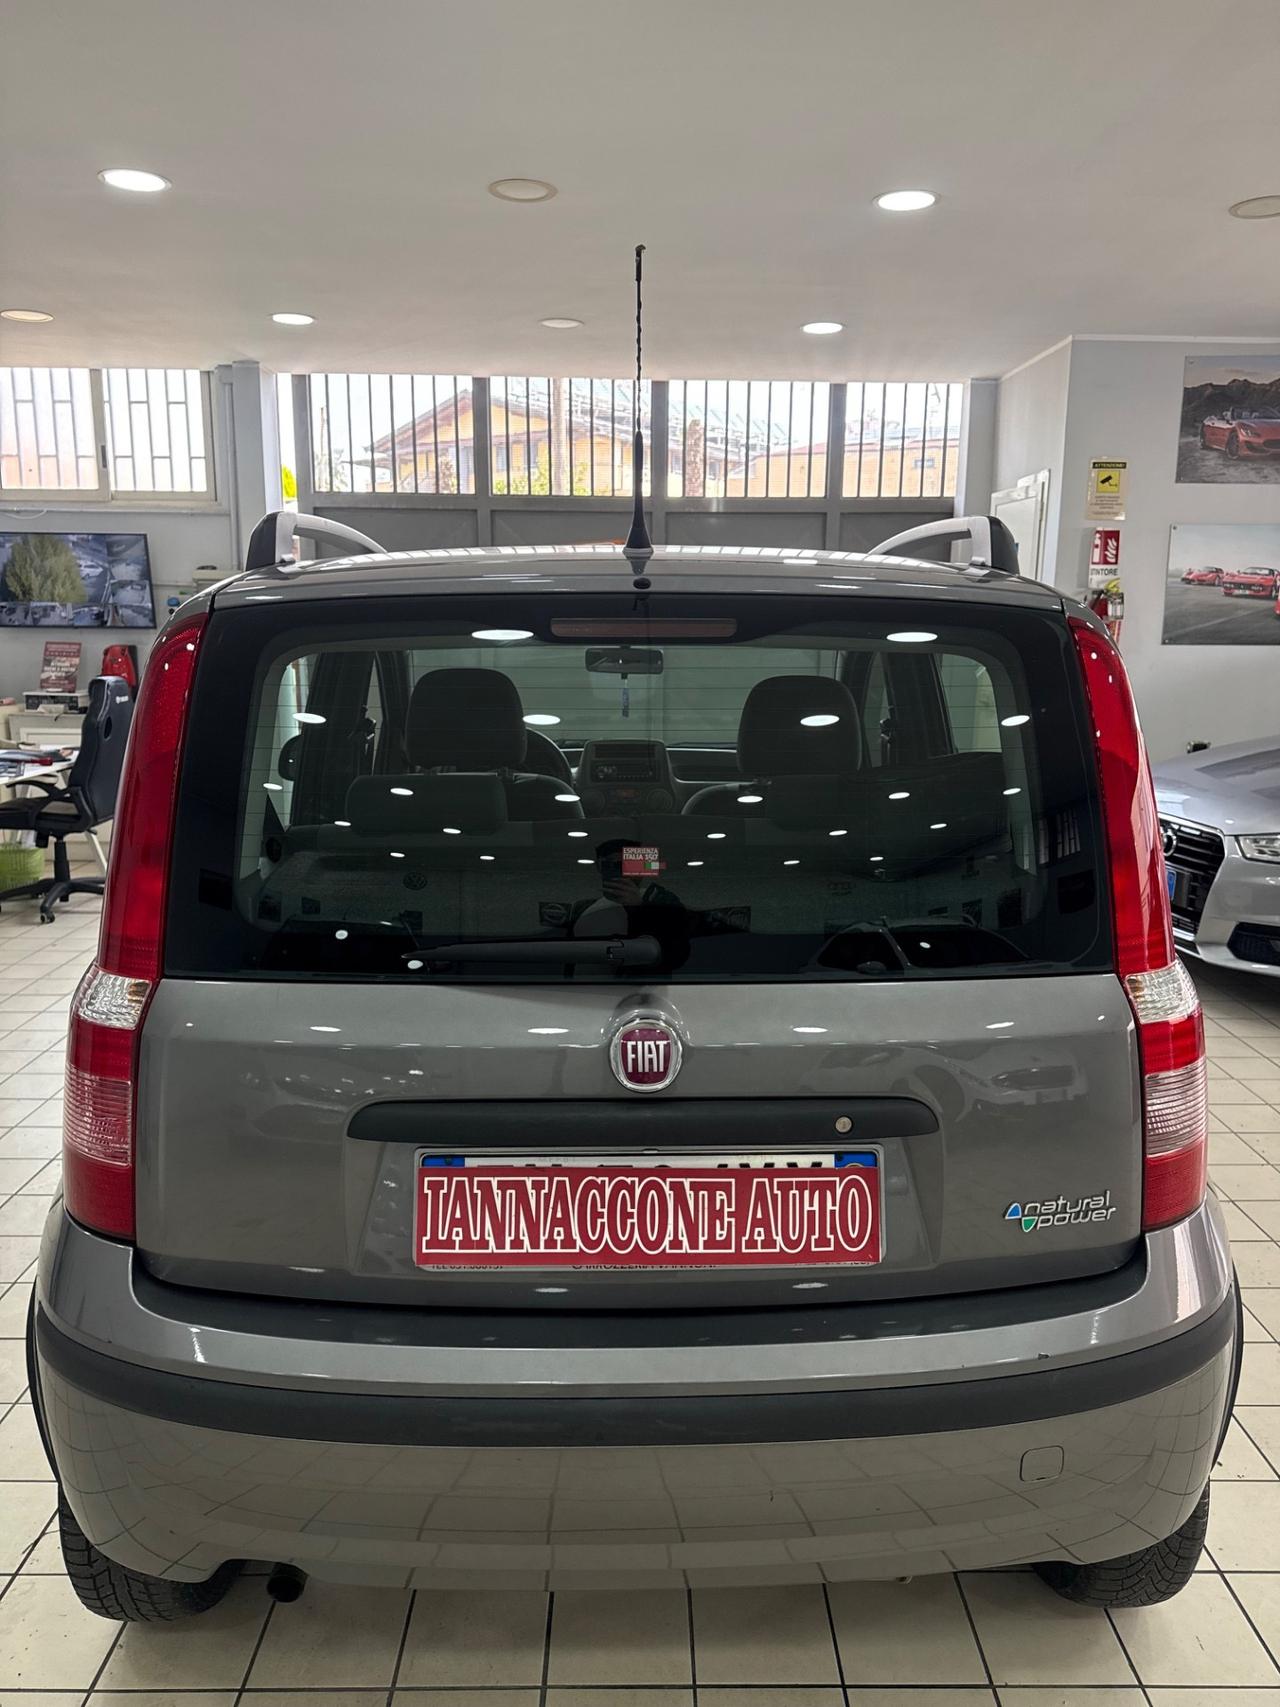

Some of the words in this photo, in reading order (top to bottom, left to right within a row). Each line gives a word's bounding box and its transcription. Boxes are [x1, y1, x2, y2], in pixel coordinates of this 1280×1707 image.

[626, 1040, 668, 1073] FIAT
[421, 1176, 736, 1254] IANNACCONE
[741, 1174, 873, 1253] AUTO
[1024, 1190, 1111, 1215] natural
[1037, 1207, 1117, 1230] power
